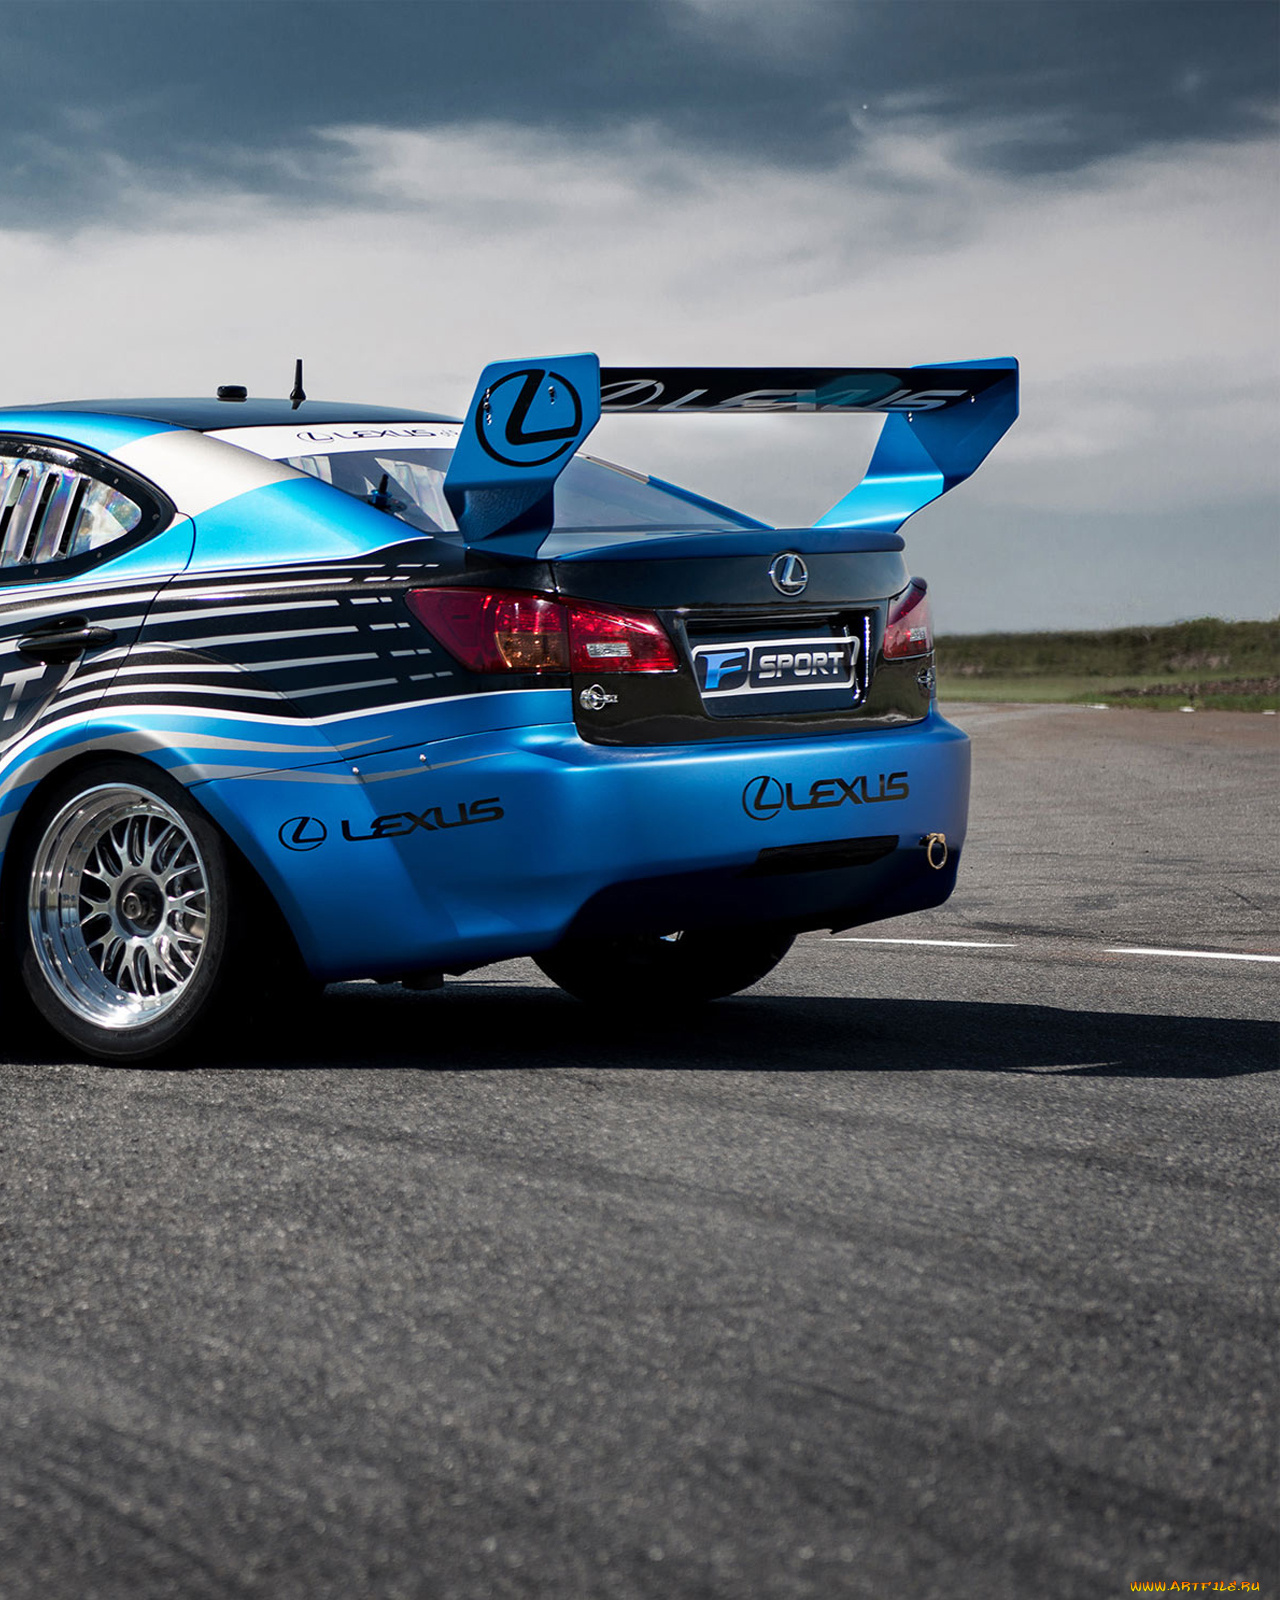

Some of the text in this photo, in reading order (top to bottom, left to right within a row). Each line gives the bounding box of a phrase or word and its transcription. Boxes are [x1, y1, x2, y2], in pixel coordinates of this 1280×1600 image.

[333, 429, 437, 439] LEXUS
[698, 651, 845, 690] F SPORT
[785, 771, 910, 811] LEXUS
[341, 797, 505, 842] LEXUS
